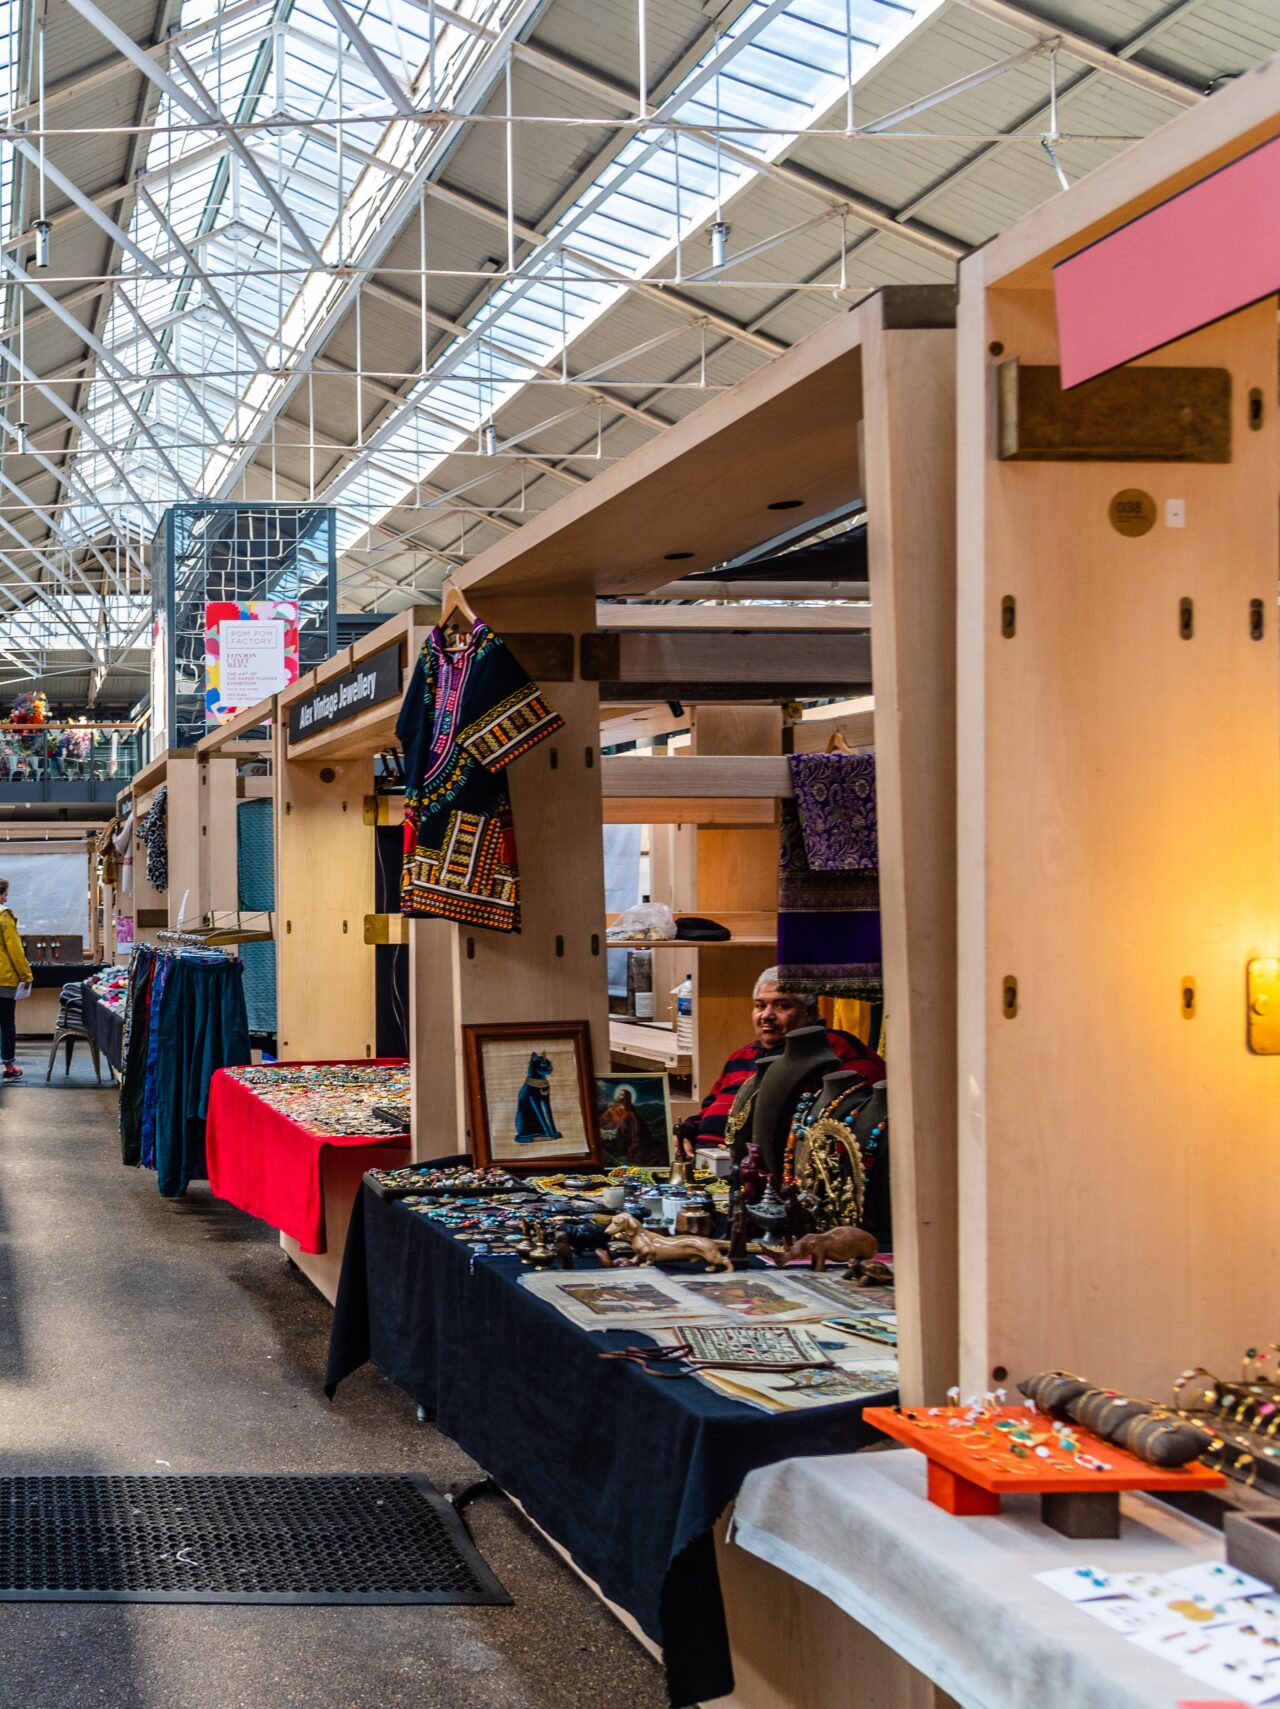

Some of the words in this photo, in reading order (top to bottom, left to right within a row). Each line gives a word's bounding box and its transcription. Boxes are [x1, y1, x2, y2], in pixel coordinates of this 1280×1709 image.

[299, 704, 314, 730] Alex
[313, 692, 338, 721] Vintage
[338, 672, 377, 709] Jewellery
